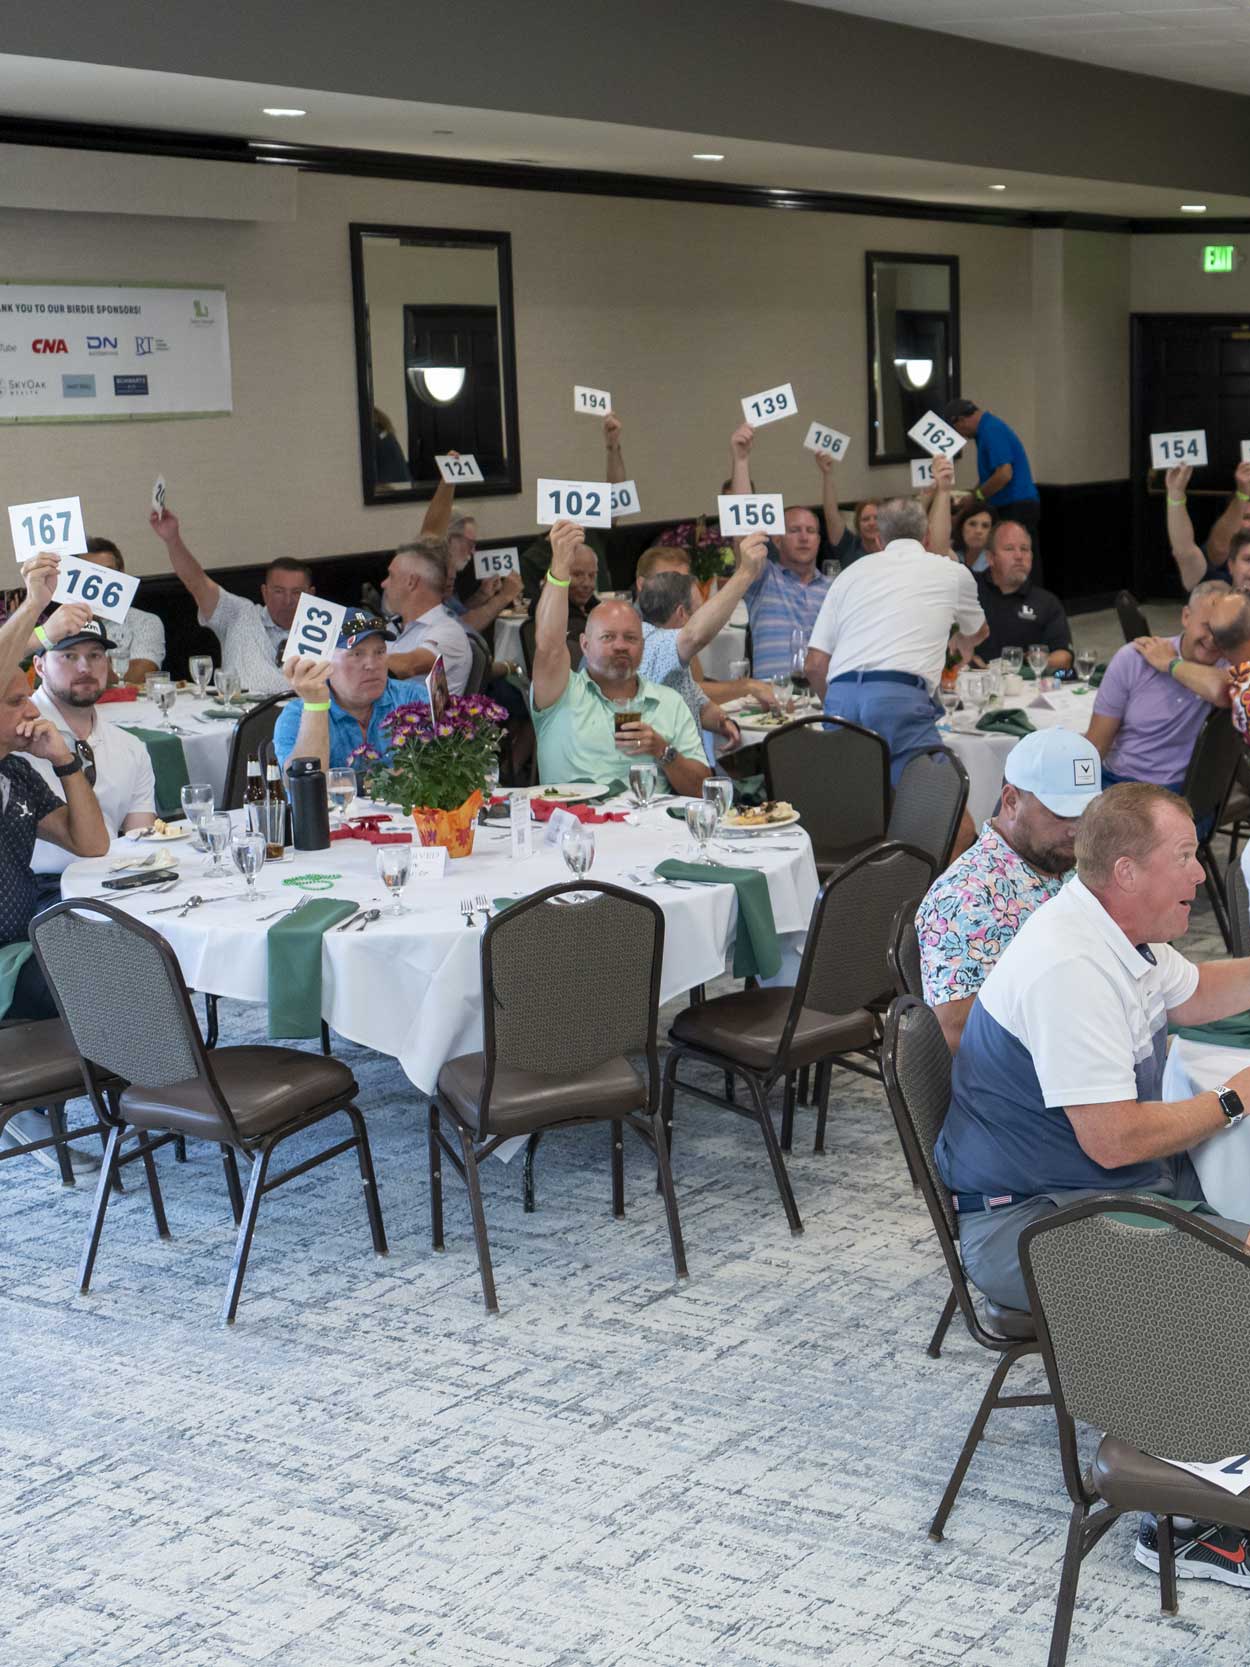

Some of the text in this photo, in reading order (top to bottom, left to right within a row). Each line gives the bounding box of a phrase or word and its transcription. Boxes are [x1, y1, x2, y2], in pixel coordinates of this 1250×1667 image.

[1205, 246, 1233, 271] EXIT
[0, 303, 142, 315] NK YOU TO OUR BIRDIE SPONSORS!
[32, 338, 69, 354] CNA
[86, 336, 118, 350] DN
[135, 336, 154, 354] RT
[580, 393, 607, 410] 194
[751, 393, 788, 418] 139
[815, 431, 843, 453] 196
[922, 422, 955, 453] 162
[1160, 438, 1199, 460] 154
[444, 461, 474, 476] 121
[549, 490, 601, 516] 102
[728, 502, 776, 526] 156
[21, 510, 72, 546] 167
[481, 554, 513, 572] 153
[66, 569, 124, 608] 166
[298, 606, 333, 656] 103
